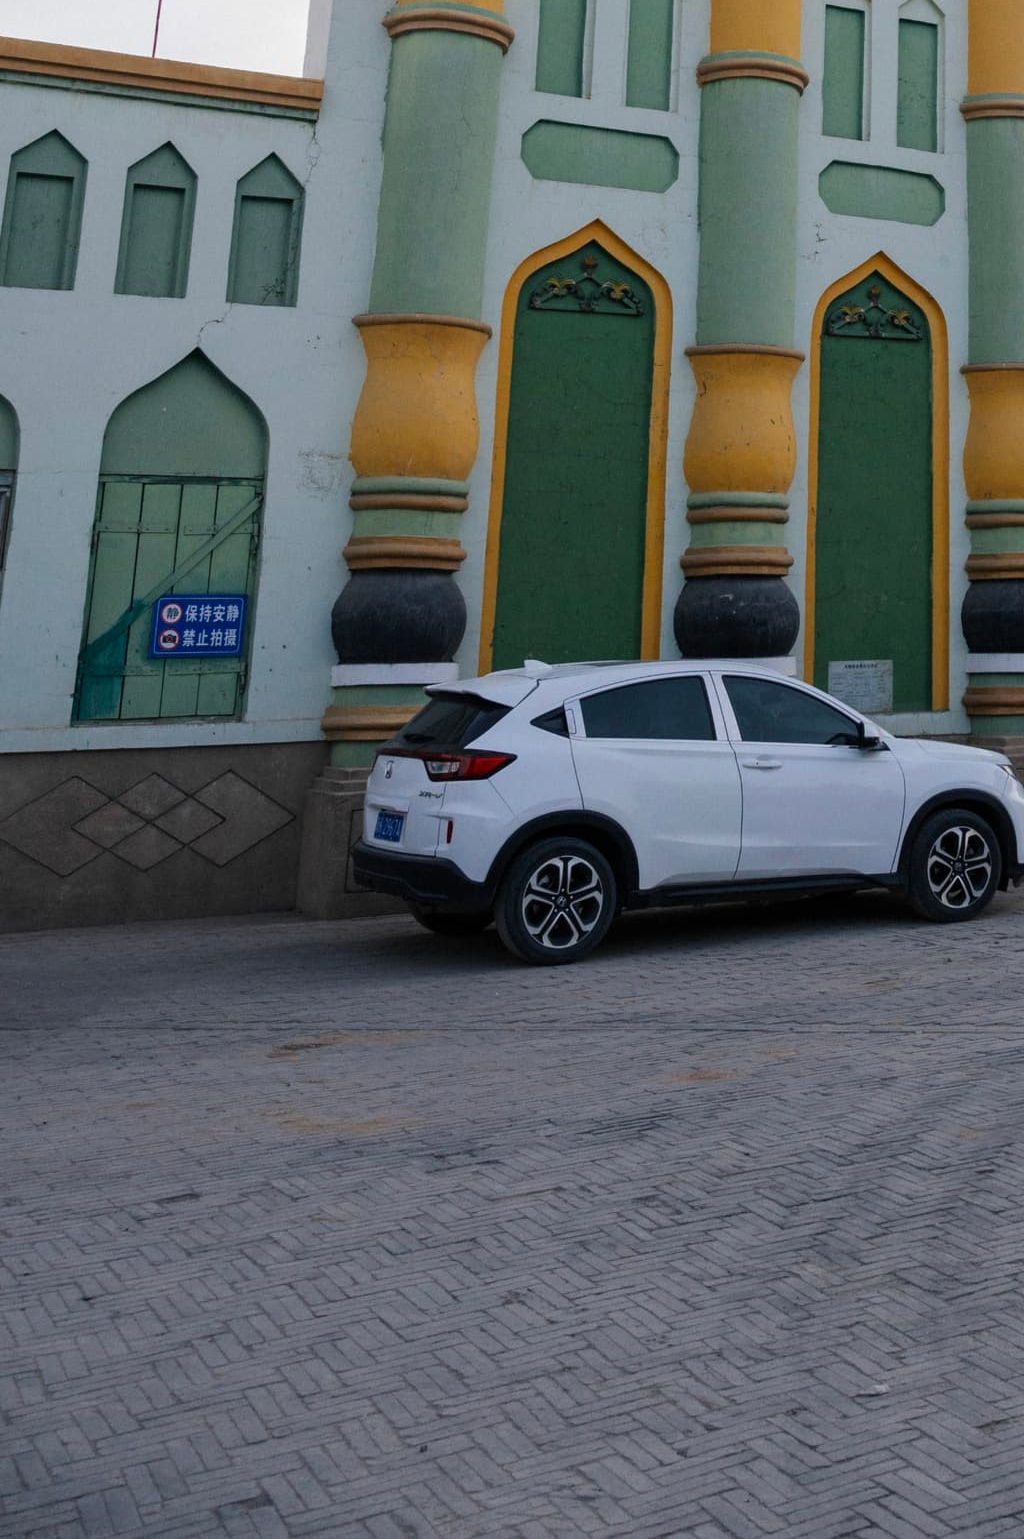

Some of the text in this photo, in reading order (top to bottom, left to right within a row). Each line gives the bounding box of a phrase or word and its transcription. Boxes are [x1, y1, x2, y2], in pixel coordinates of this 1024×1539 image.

[166, 607, 179, 619] 静
[185, 604, 240, 622] 保持安静
[182, 628, 237, 647] 禁止拍摄
